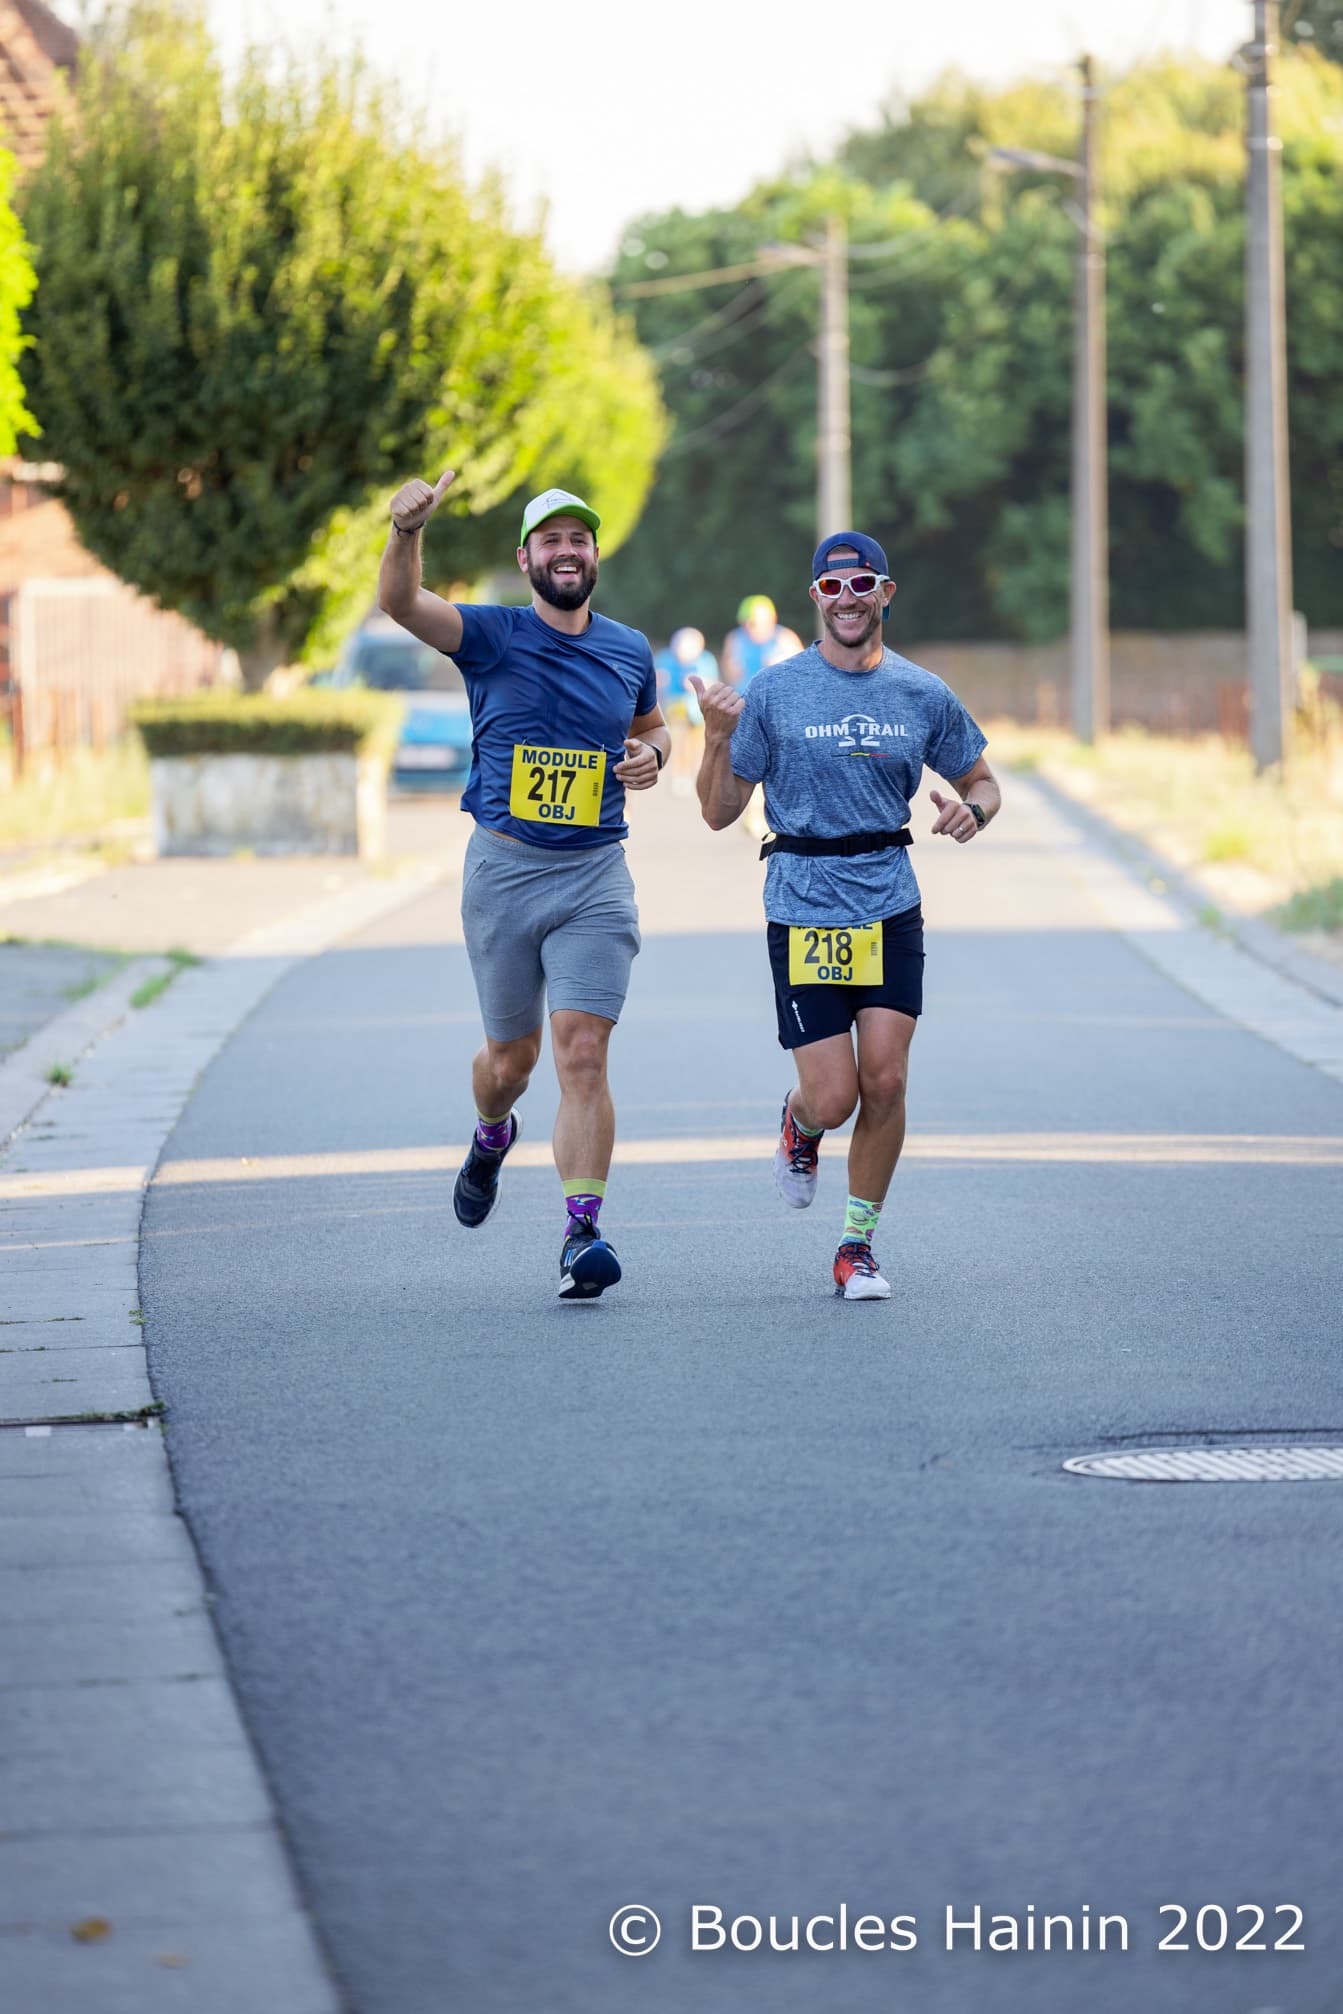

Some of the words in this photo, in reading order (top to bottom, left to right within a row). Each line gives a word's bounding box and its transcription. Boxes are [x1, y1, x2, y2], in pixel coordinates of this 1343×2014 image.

[522, 749, 598, 769] MODULE
[527, 767, 577, 803] 217
[538, 803, 576, 820] OBJ
[804, 930, 853, 965] 218
[817, 966, 853, 981] OBJ
